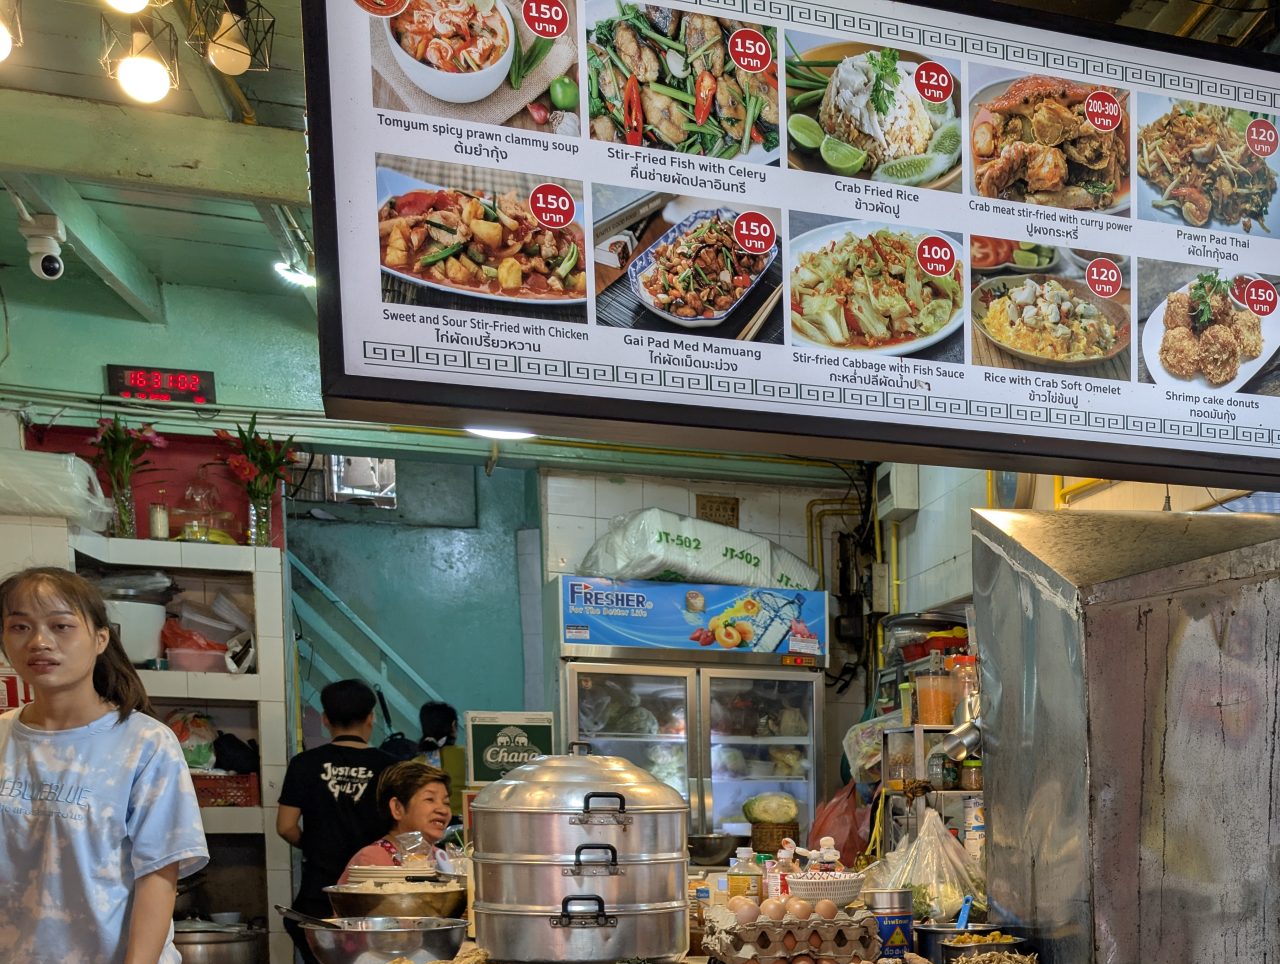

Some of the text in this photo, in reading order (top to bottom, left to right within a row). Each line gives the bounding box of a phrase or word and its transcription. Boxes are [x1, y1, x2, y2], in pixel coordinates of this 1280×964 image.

[529, 3, 563, 21] 150
[535, 21, 557, 33] บาท
[735, 38, 766, 56] 150
[740, 57, 761, 68] บาท
[919, 70, 949, 87] 120
[924, 87, 944, 99] บาท
[1088, 100, 1119, 116] 200-300
[1094, 116, 1112, 127] บาท
[377, 114, 579, 154] Tomyum spicy prawn clammy soup
[1250, 127, 1276, 142] 120
[453, 141, 508, 162] ต้มยำกุ้ง
[1254, 144, 1271, 153] บาท
[607, 147, 767, 182] Stir-Fried Fish with Celery
[834, 181, 920, 202] Crab Fried Rice
[536, 193, 570, 211] 150
[854, 199, 900, 219] ข้าวผัดปู
[542, 211, 564, 223] บาท
[969, 200, 1133, 234] Crab meat stir-fried with curry power
[739, 220, 771, 237] 150
[745, 238, 765, 249] บาท
[1176, 229, 1250, 249] Prawn Pad Thai
[922, 245, 951, 261] 100
[1188, 245, 1239, 263] ผัดไทกุ้งสด
[927, 262, 946, 273] บาท
[1090, 267, 1118, 283] 120
[1095, 283, 1113, 293] บาท
[1249, 288, 1274, 302] 150
[1254, 303, 1269, 312] บาท
[383, 309, 589, 341] Sweet and Sour Stir-Fried with Chicken
[435, 328, 541, 352] ไก่ผัดเปรี้ยวหวาน
[623, 334, 762, 360] Gai Pad Med Mamuang
[649, 350, 738, 372] ไก่ผัดเม็ดมะม่วง
[792, 352, 965, 380] Stir-fried Cabbage with Fish Sauce
[829, 370, 931, 391] กะหล่ำปลีผัดน้ำปา
[984, 372, 1121, 396] Rice with Crab Soft Omelet
[1028, 390, 1079, 409] ข้าวไข่ข้นปู
[1165, 390, 1260, 409] Shrimp cake donuts
[1189, 408, 1237, 423] ทอดมันกุ้ง
[657, 532, 702, 550] JT-502
[569, 582, 647, 608] FRESHER
